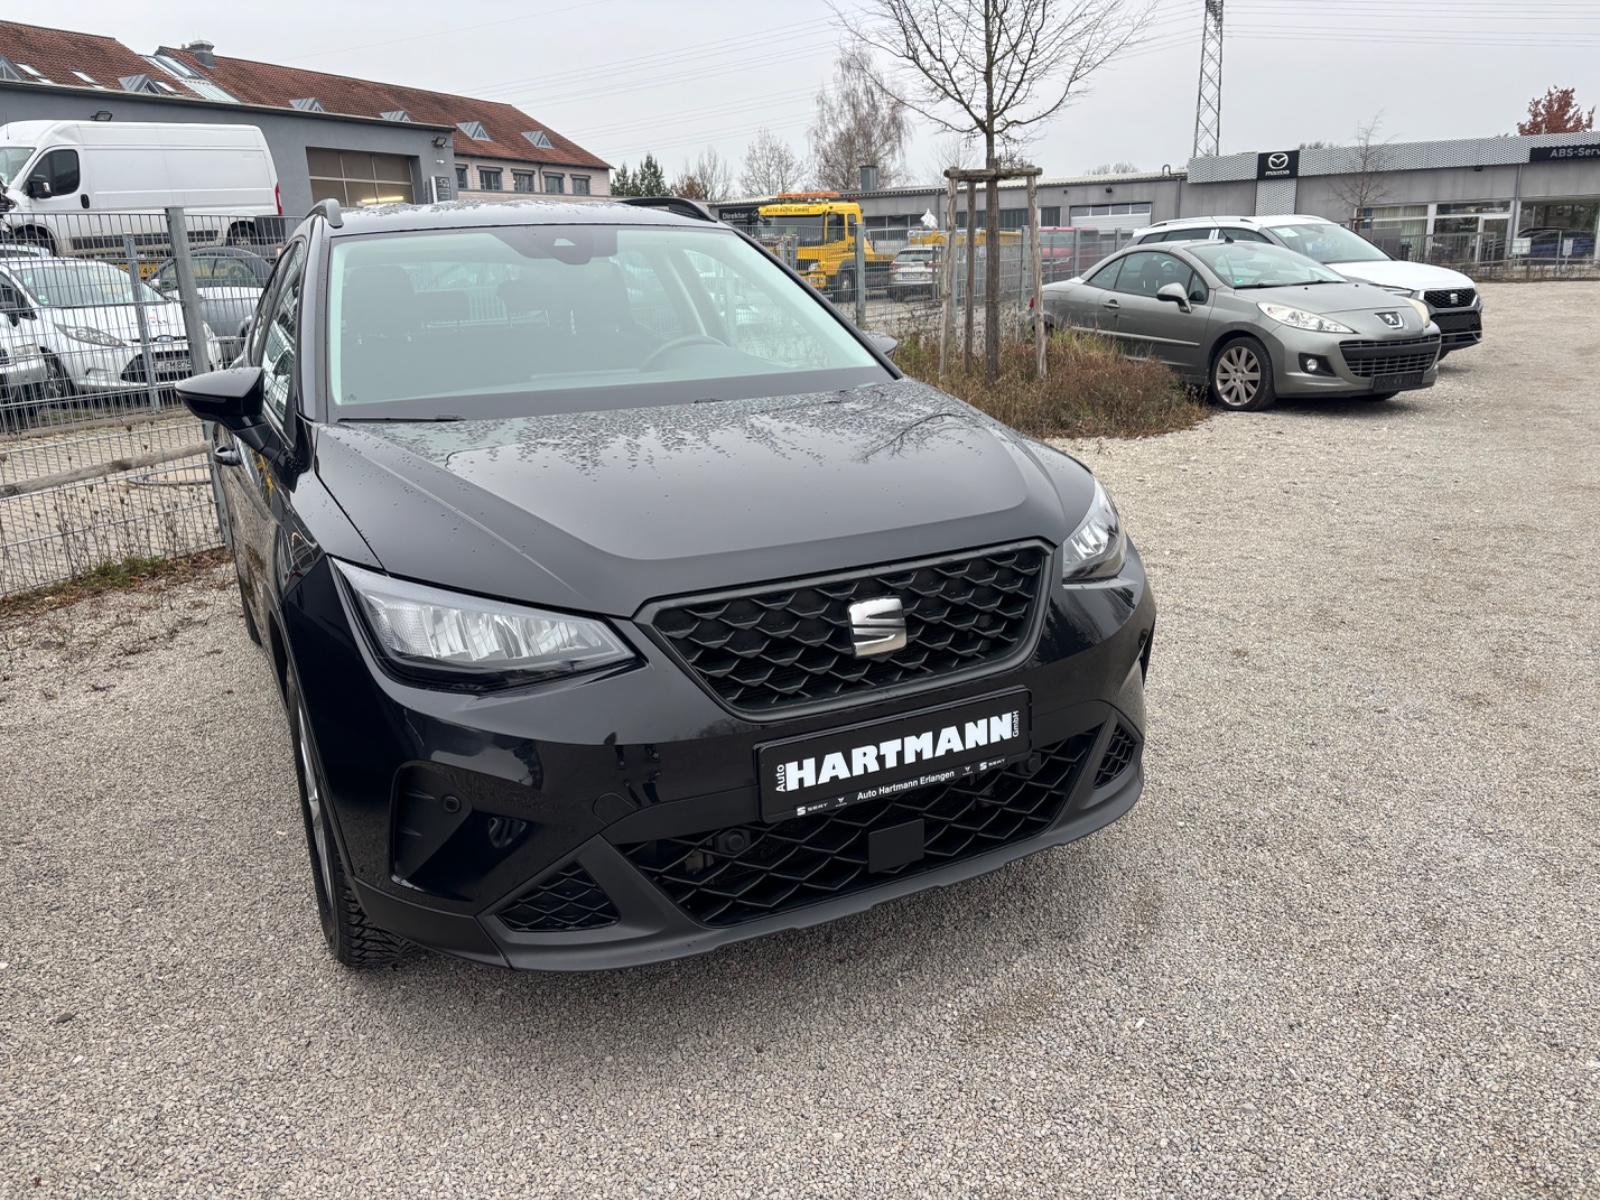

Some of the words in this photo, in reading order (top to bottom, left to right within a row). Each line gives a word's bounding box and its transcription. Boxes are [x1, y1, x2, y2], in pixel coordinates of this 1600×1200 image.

[775, 764, 786, 792] Auto
[785, 712, 1013, 791] HARTMANN
[1012, 710, 1020, 737] GmbH
[857, 789, 877, 800] Auto
[879, 780, 918, 795] Hartmann
[920, 770, 955, 785] Erlangen
